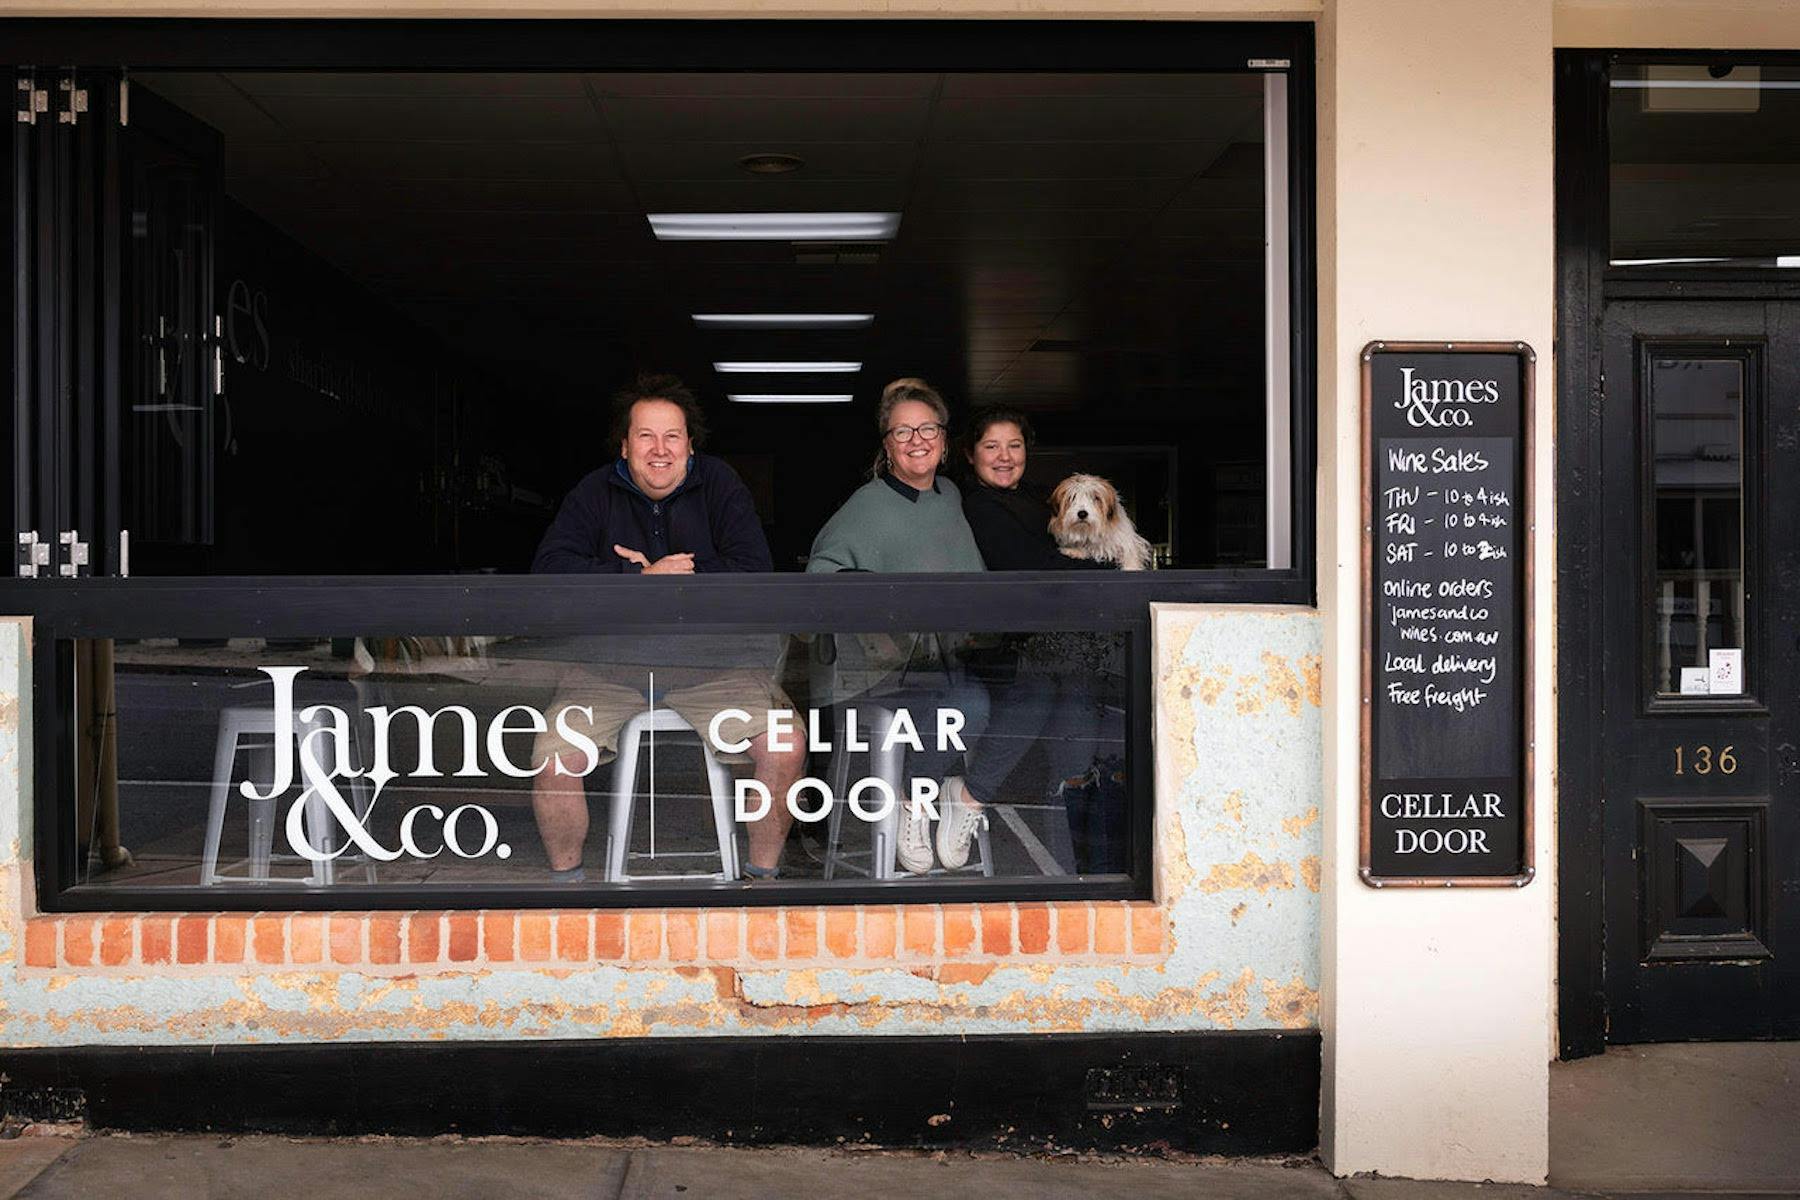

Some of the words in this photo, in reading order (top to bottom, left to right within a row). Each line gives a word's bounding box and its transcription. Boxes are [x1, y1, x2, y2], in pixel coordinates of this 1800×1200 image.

[1394, 367, 1499, 409] James
[1406, 388, 1474, 428] &co.
[1430, 446, 1490, 474] Sales
[1383, 485, 1420, 510] THU
[1444, 488, 1460, 505] 10
[1384, 512, 1416, 536] FRI
[1444, 512, 1459, 530] 10
[1385, 542, 1419, 565] SAT
[1443, 541, 1458, 558] 10
[1461, 542, 1476, 556] to
[1438, 578, 1493, 599] orders
[1384, 652, 1427, 674] Local
[1430, 653, 1497, 684] delivery
[1387, 681, 1421, 705] Free
[1423, 682, 1489, 713] freight
[240, 666, 598, 801] James
[708, 708, 968, 754] CELLAR
[1675, 744, 1737, 775] 136
[284, 722, 513, 862] &co.
[734, 775, 943, 823] DOOR
[1380, 793, 1506, 819] CELLAR
[1394, 828, 1491, 854] DOOR
